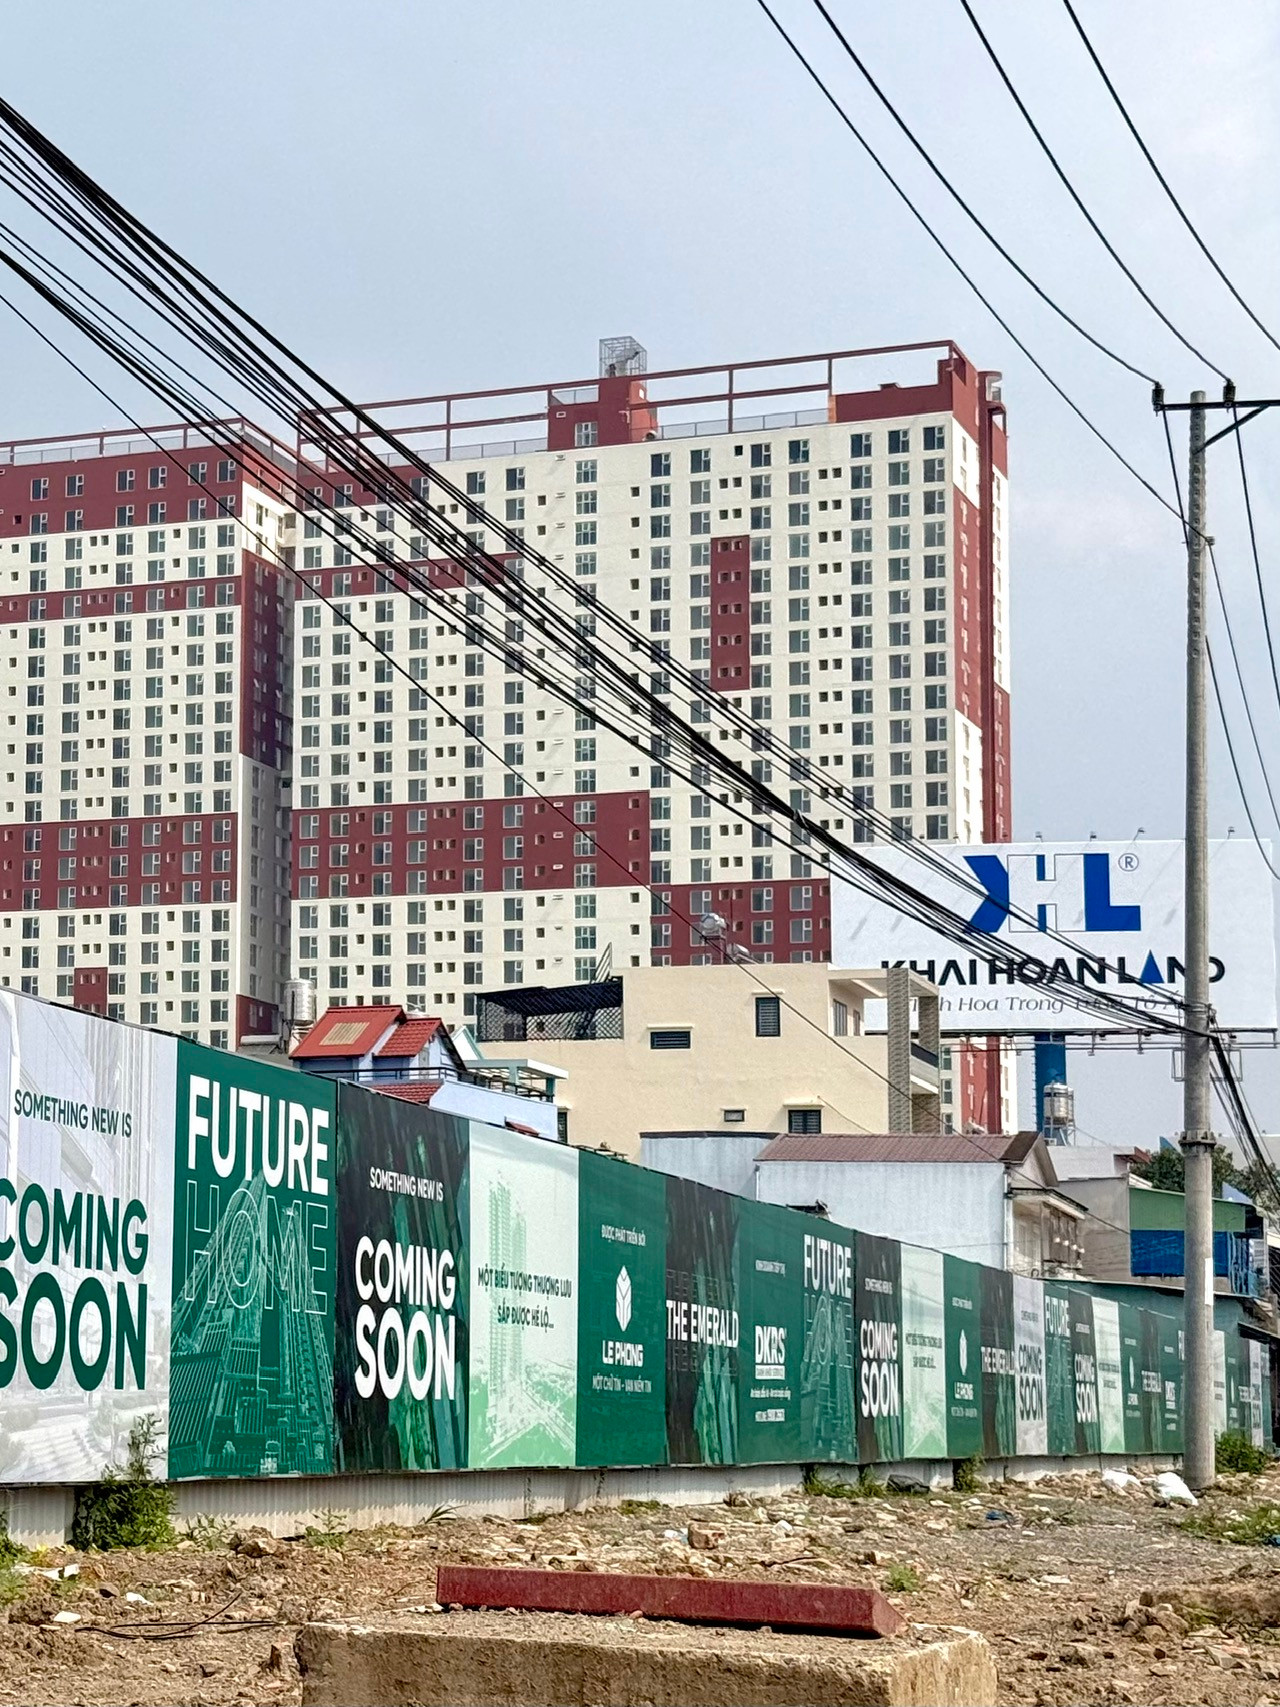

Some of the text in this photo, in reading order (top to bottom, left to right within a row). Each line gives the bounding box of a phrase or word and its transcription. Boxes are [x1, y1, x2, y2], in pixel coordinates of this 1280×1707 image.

[988, 956, 1106, 986] HOAN
[908, 996, 952, 1012] Th
[958, 997, 998, 1012] Hoa
[1005, 996, 1064, 1014] Trong
[14, 1088, 132, 1138] SOMETHING NEW IS
[187, 1074, 330, 1196] FUTURE
[369, 1166, 444, 1202] SOMETHING NEW IS
[185, 1179, 329, 1316] HOME
[803, 1234, 852, 1299] FUTURE
[354, 1235, 456, 1311] COMING
[478, 1263, 493, 1292] MỘT
[510, 1270, 532, 1296] TƯỢNG
[534, 1275, 559, 1300] THƯỢNG
[561, 1278, 572, 1298] LƯU
[512, 1305, 530, 1330] ĐƯỢC
[532, 1304, 539, 1327] HÉ
[666, 1300, 739, 1348] THE EMERALD
[1045, 1295, 1070, 1338] FUTURE
[354, 1303, 456, 1401] SOON
[602, 1339, 614, 1364] LE
[615, 1341, 644, 1367] PHONG
[755, 1325, 786, 1364] DKRS
[860, 1319, 898, 1360] COMING
[861, 1360, 900, 1418] SOON
[1019, 1375, 1043, 1420] SOON
[1076, 1383, 1097, 1423] SOON
